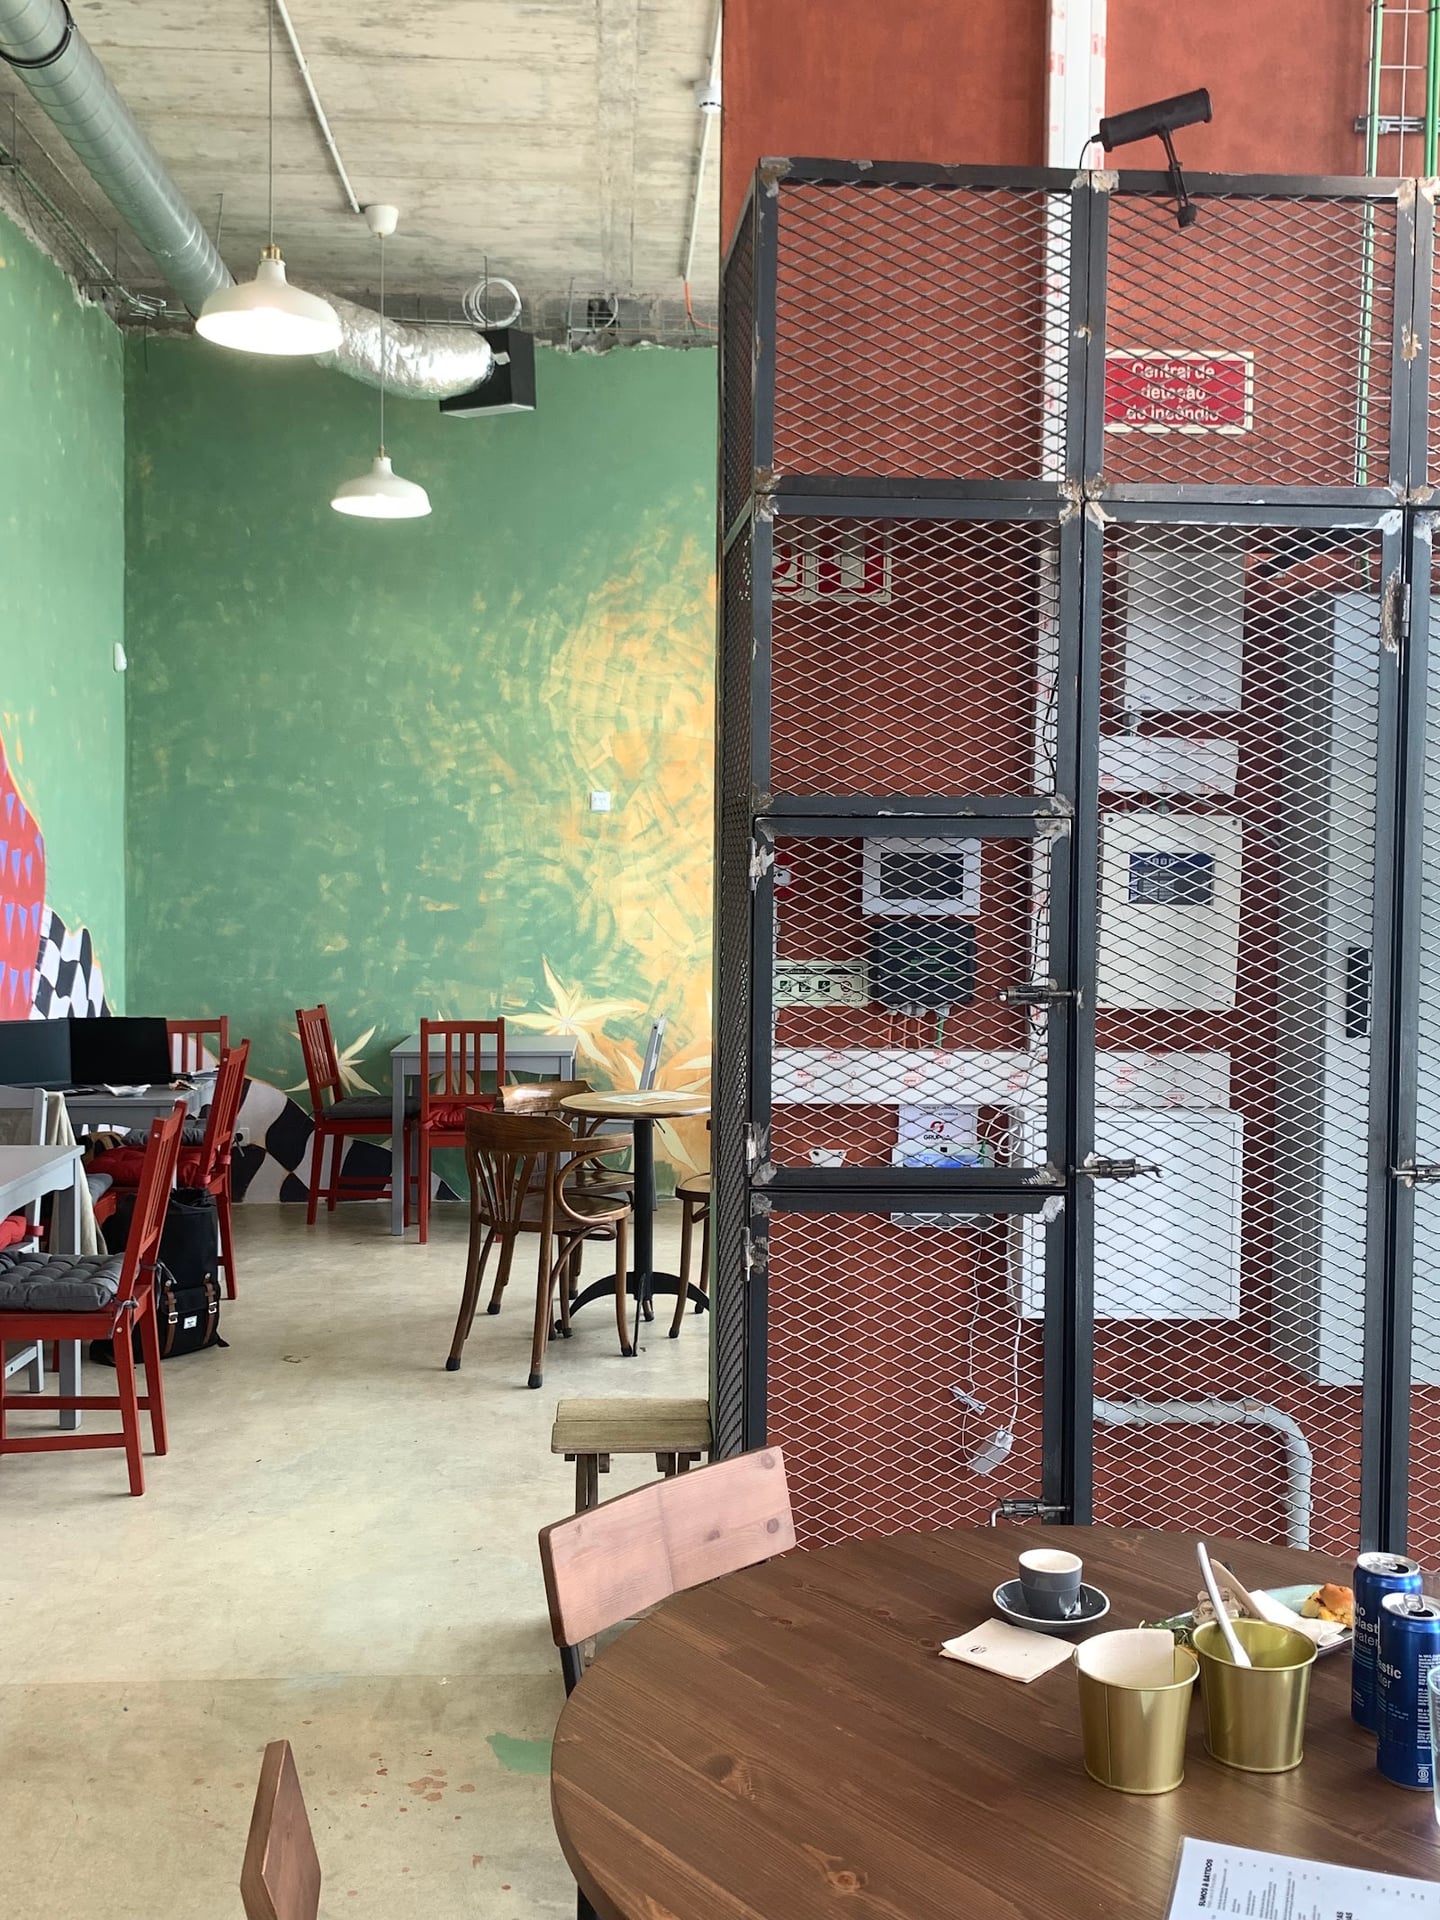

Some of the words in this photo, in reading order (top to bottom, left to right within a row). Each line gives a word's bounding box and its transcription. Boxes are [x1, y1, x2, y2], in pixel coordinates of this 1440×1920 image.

[1132, 362, 1190, 379] Central
[1194, 365, 1216, 379] de
[1354, 1616, 1379, 1634] plast
[1377, 1659, 1402, 1680] astic
[1198, 1888, 1208, 1907] SUMOS
[1203, 1859, 1213, 1882] BATIDOS
